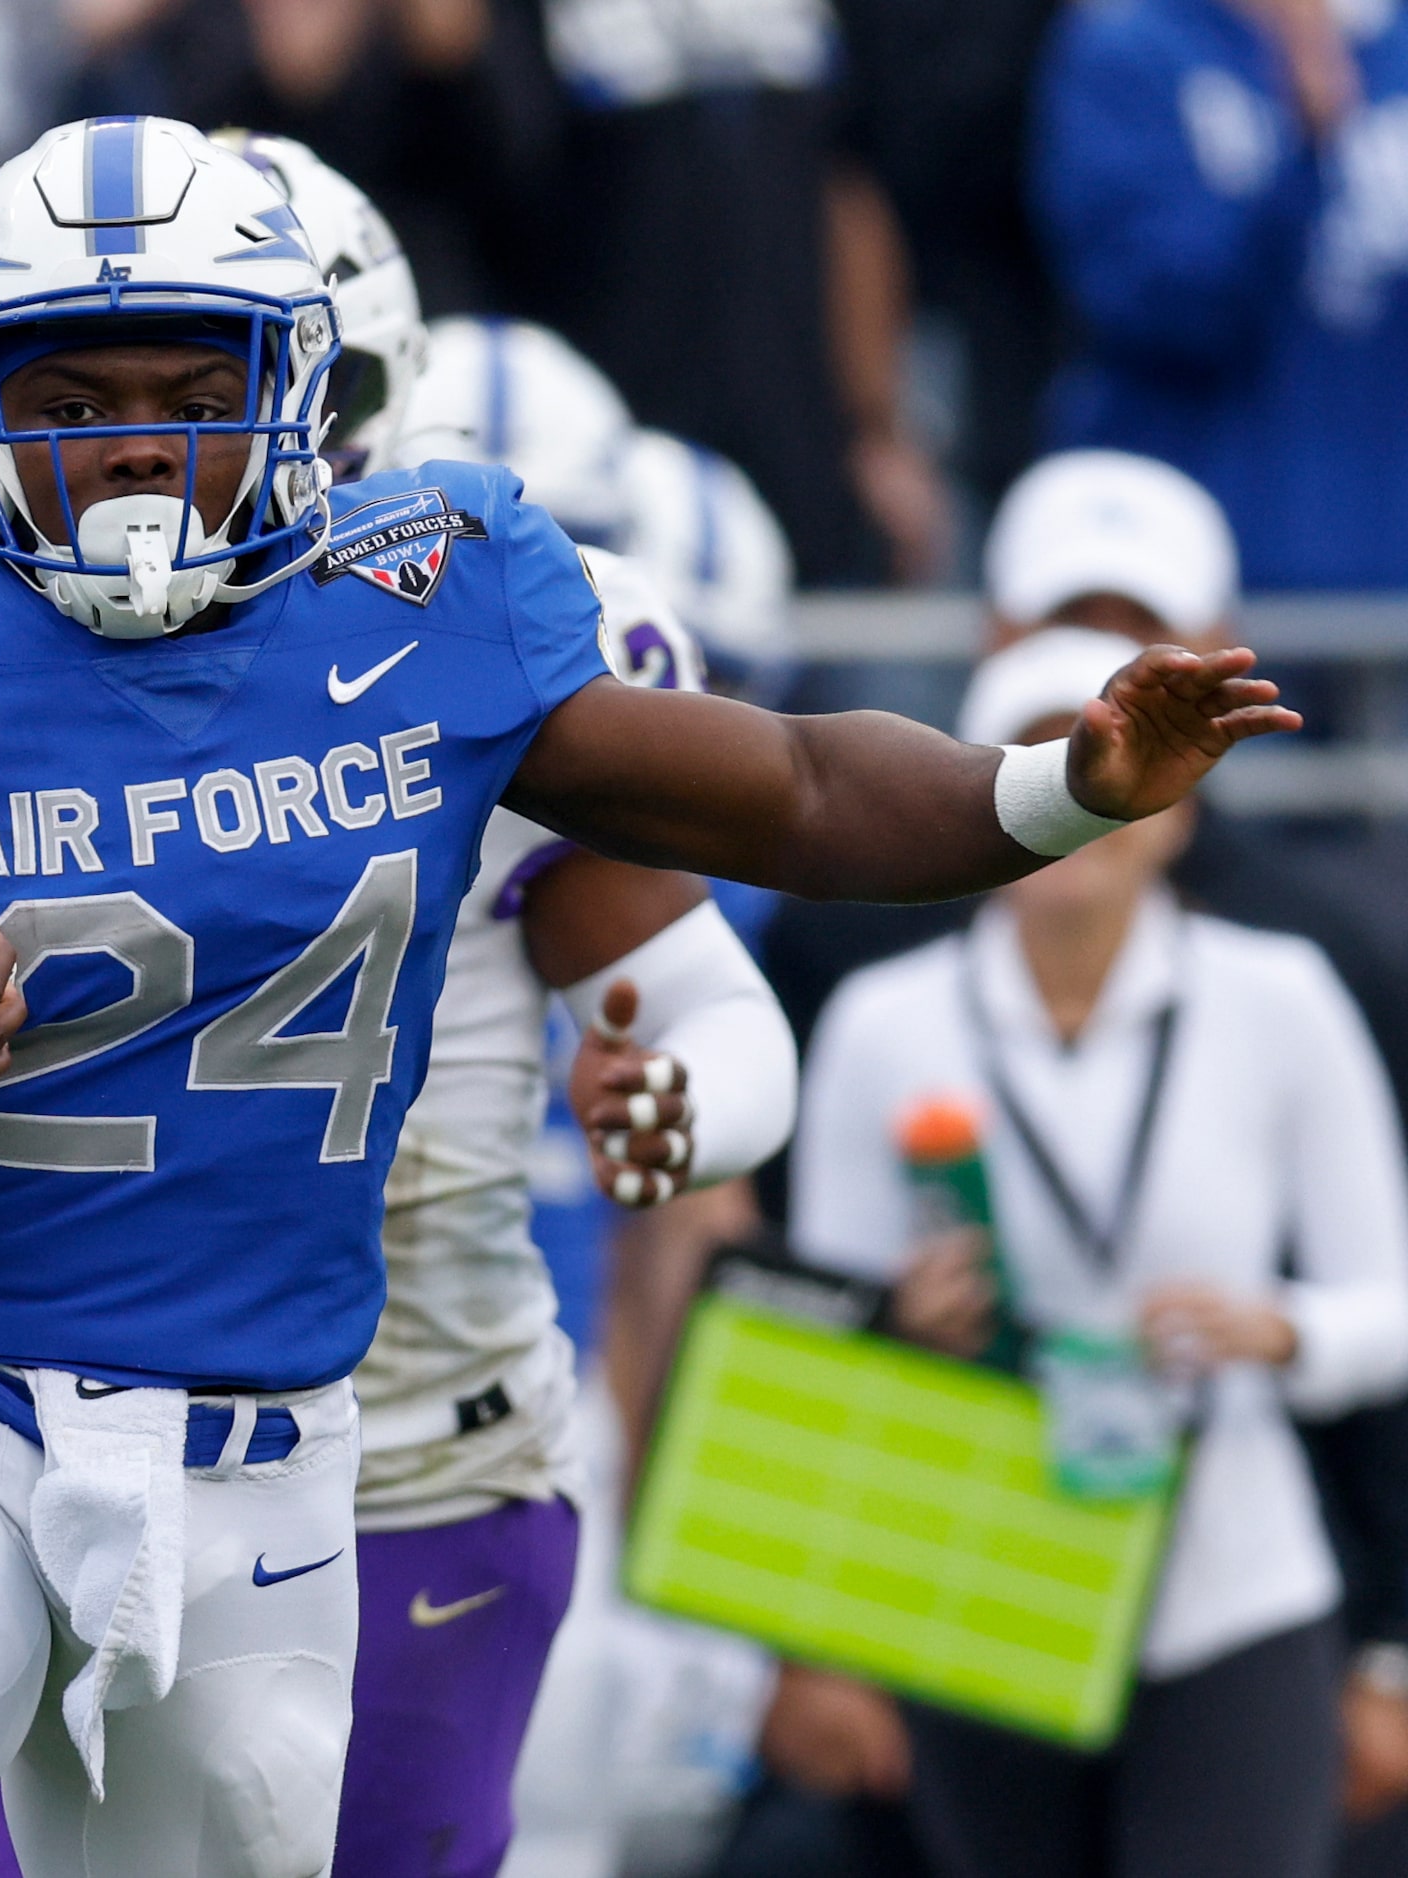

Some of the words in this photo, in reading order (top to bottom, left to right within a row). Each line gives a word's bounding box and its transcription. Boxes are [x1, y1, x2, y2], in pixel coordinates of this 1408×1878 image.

[327, 534, 387, 569] ARMED
[388, 514, 465, 541] FORCES
[375, 542, 427, 566] BOWL
[123, 721, 442, 867] FORCE
